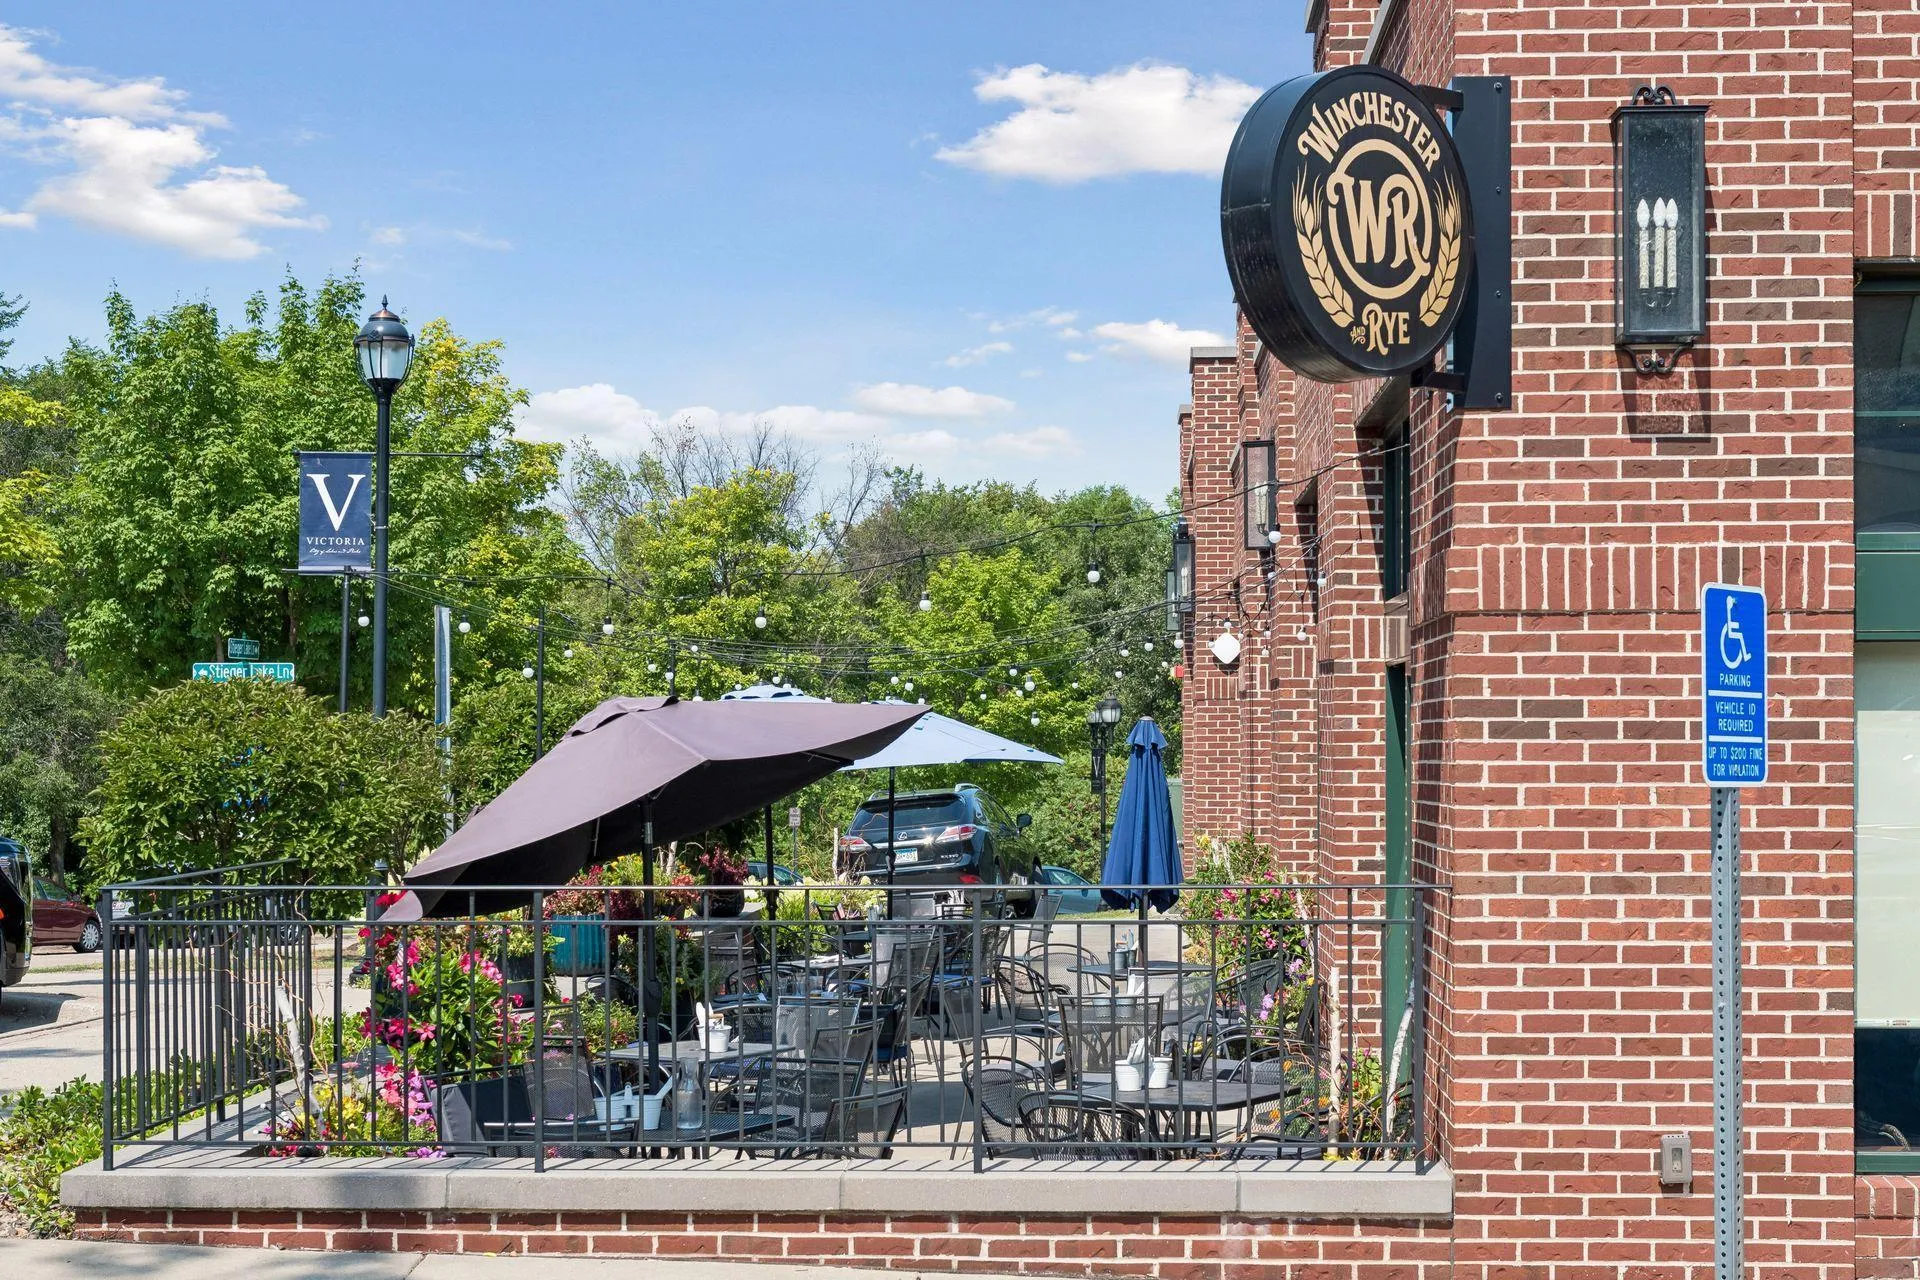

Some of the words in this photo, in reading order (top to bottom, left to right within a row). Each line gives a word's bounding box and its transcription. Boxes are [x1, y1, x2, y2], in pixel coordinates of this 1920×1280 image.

[1297, 91, 1441, 172] WINCHESTER
[1326, 172, 1430, 270] WR
[1362, 302, 1411, 355] RYE
[306, 473, 366, 532] V
[306, 536, 365, 546] VICTORIA
[250, 664, 275, 678] Lke
[277, 664, 290, 679] Ln
[1719, 673, 1752, 687] PARKING
[1715, 701, 1745, 715] VEHICLE
[1748, 703, 1757, 715] ID
[1718, 718, 1754, 732] REQUIRED
[1708, 746, 1717, 759] UP
[1720, 747, 1728, 759] TO
[1730, 746, 1747, 760] $200
[1749, 747, 1763, 761] FINE
[1713, 763, 1726, 776] FOR
[1728, 763, 1760, 777] VIOLATION
